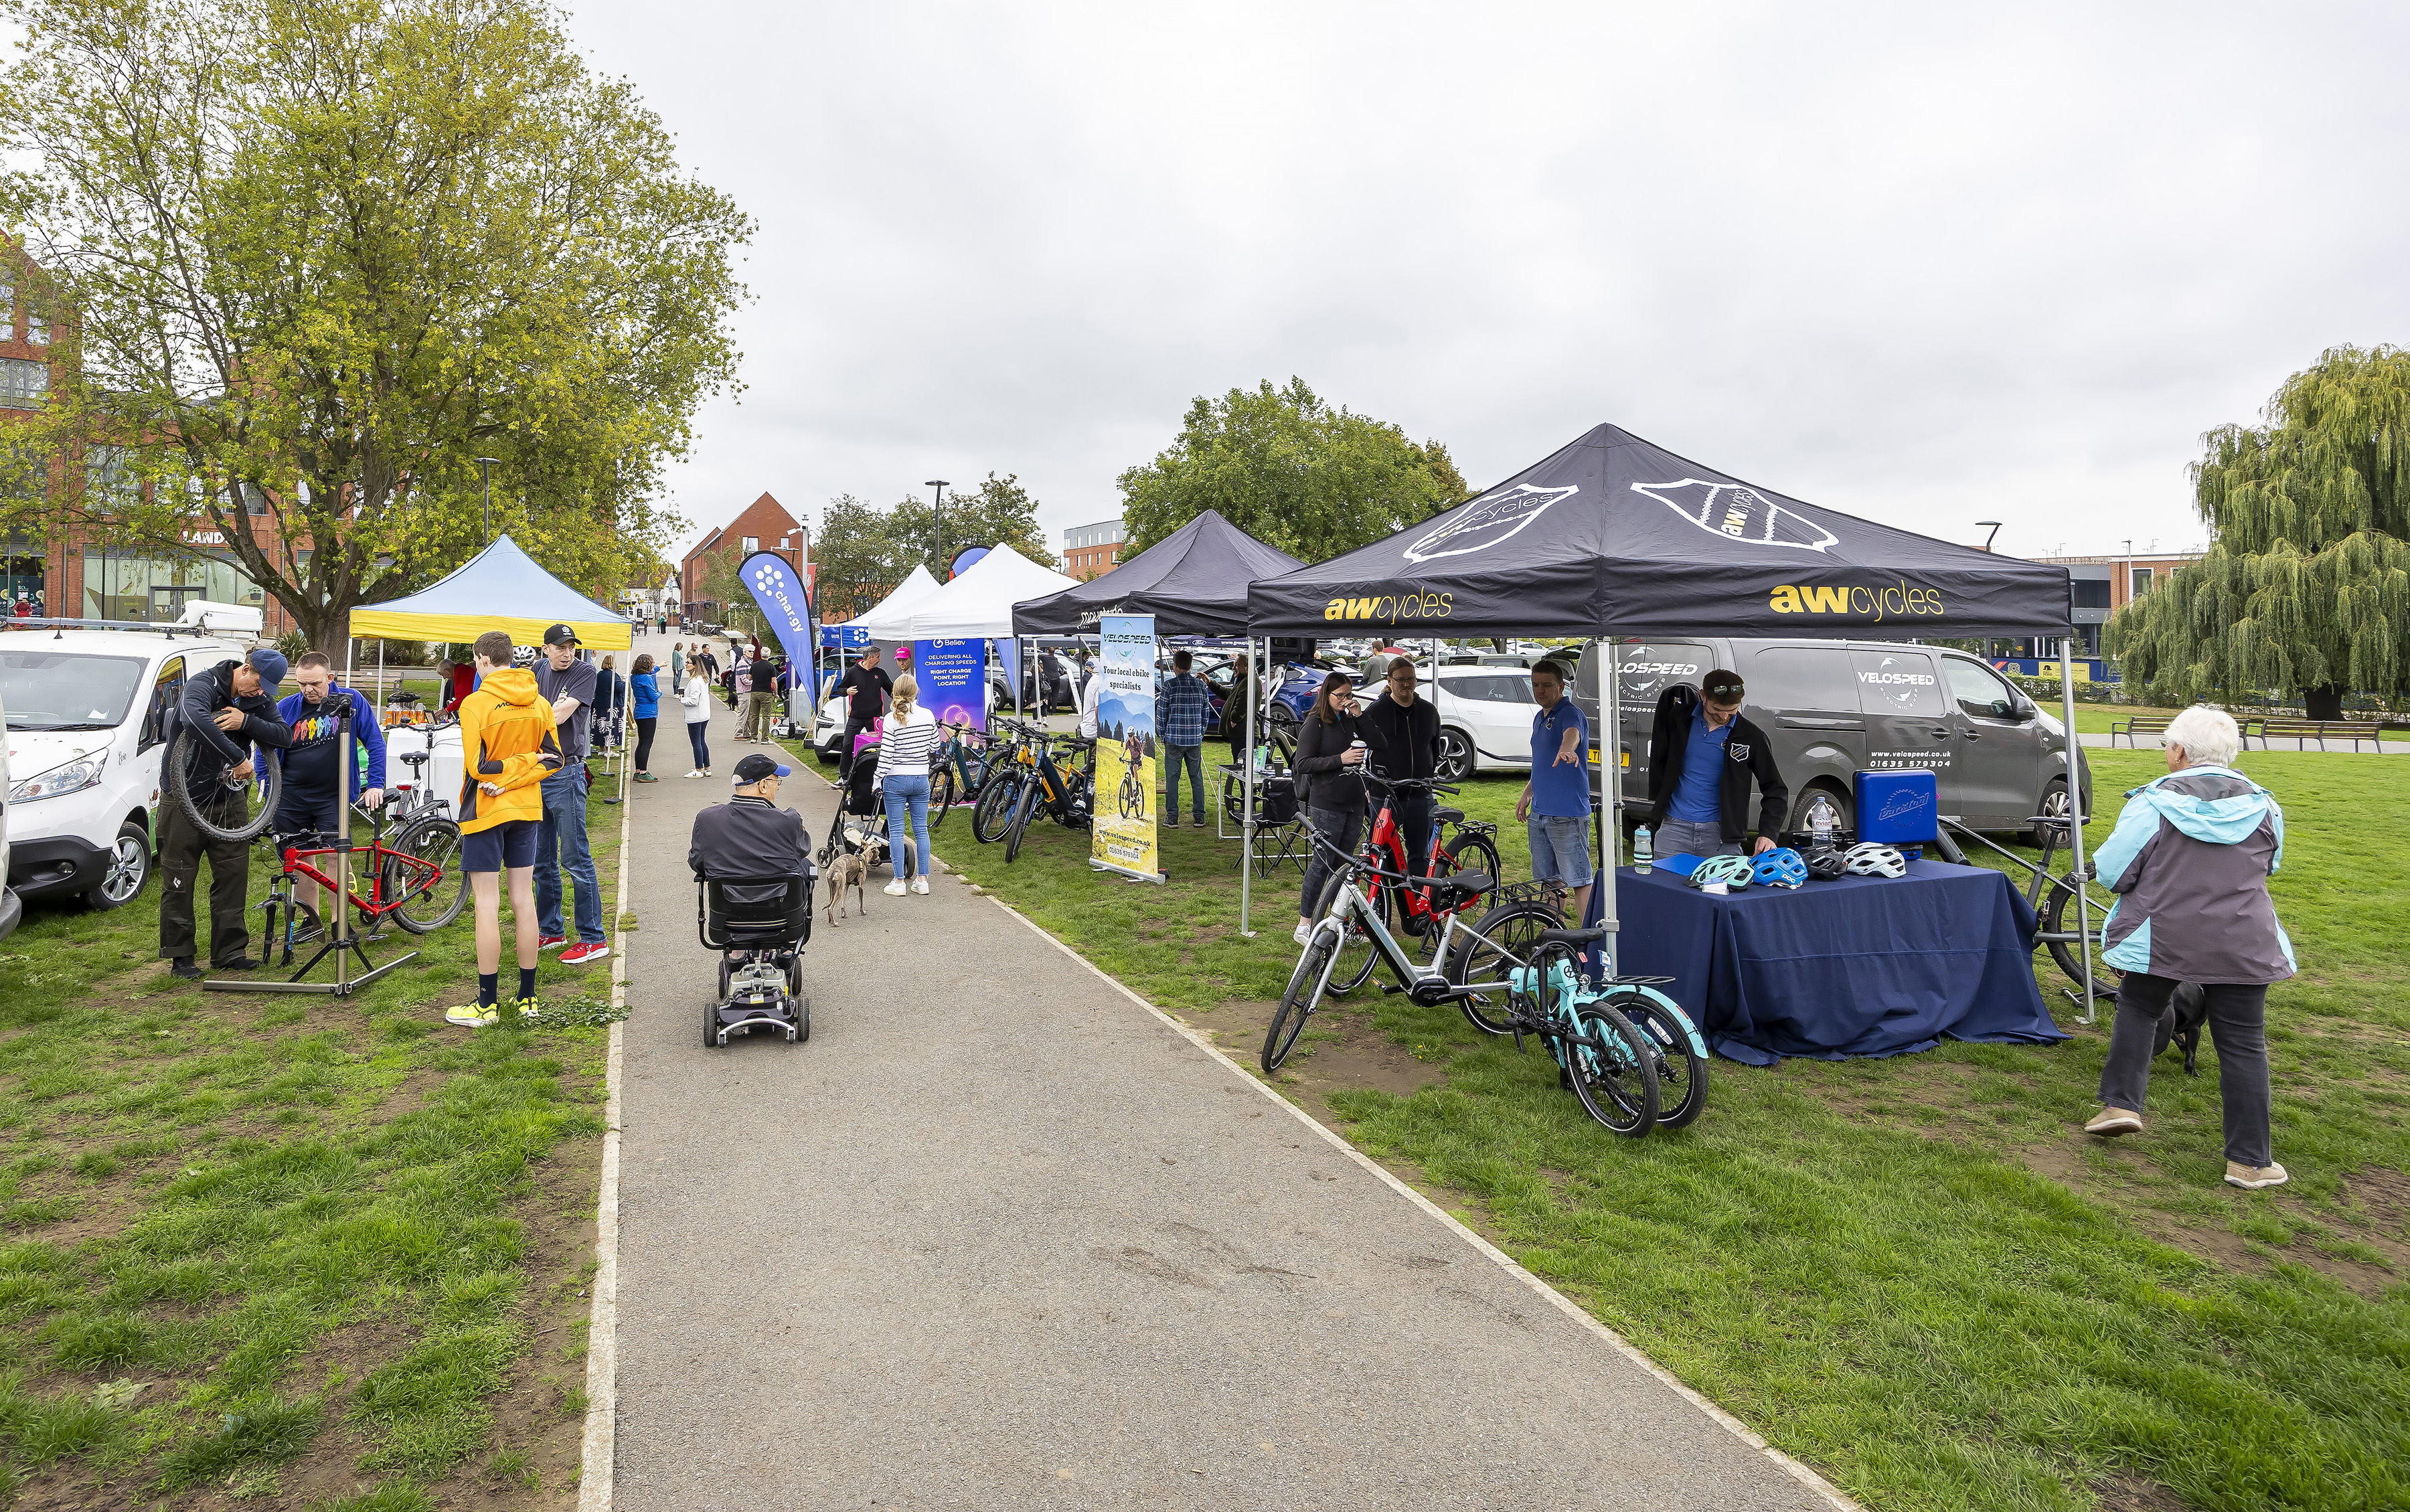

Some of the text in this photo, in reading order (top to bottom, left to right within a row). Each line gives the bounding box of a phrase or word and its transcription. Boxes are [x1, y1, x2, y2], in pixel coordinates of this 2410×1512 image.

[183, 531, 230, 544] LAND
[1324, 586, 1453, 625] awcycles
[1769, 580, 1944, 622] awcycles
[775, 590, 804, 633] char.gy
[1103, 634, 1151, 644] VELOSPEED
[1103, 666, 1149, 677] Your local ebike
[1857, 671, 1934, 685] VELOSPEED
[1109, 681, 1141, 690] specialists
[1646, 677, 1666, 697] BIKES
[1880, 687, 1907, 709] ELECTRIC
[1871, 751, 1951, 760] www.velospeed.co.uk
[1099, 829, 1151, 847] www.velospeed.co.uk
[1109, 847, 1139, 859] 01635 579304
